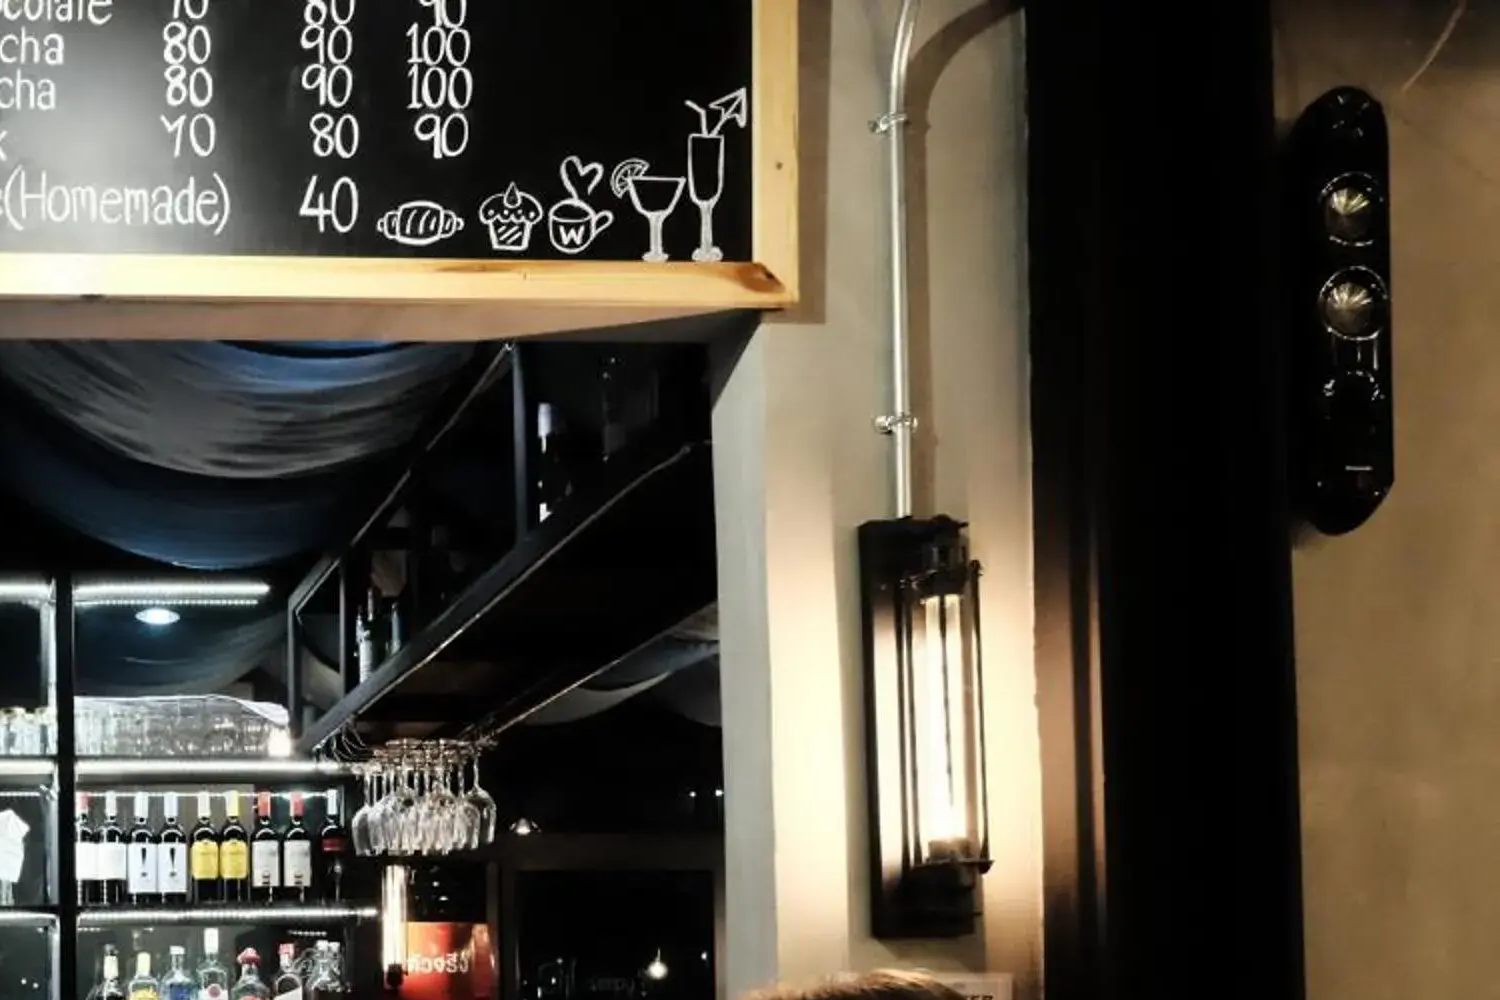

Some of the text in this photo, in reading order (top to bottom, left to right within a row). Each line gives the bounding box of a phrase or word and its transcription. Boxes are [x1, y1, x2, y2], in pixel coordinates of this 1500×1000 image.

[162, 21, 212, 65] 80
[301, 24, 352, 64] 90
[406, 22, 471, 66] 100
[164, 64, 213, 107] 80
[302, 63, 353, 107] 90
[407, 63, 473, 109] 100
[310, 112, 359, 159] 80
[414, 112, 469, 159] 90
[300, 175, 358, 233] 40
